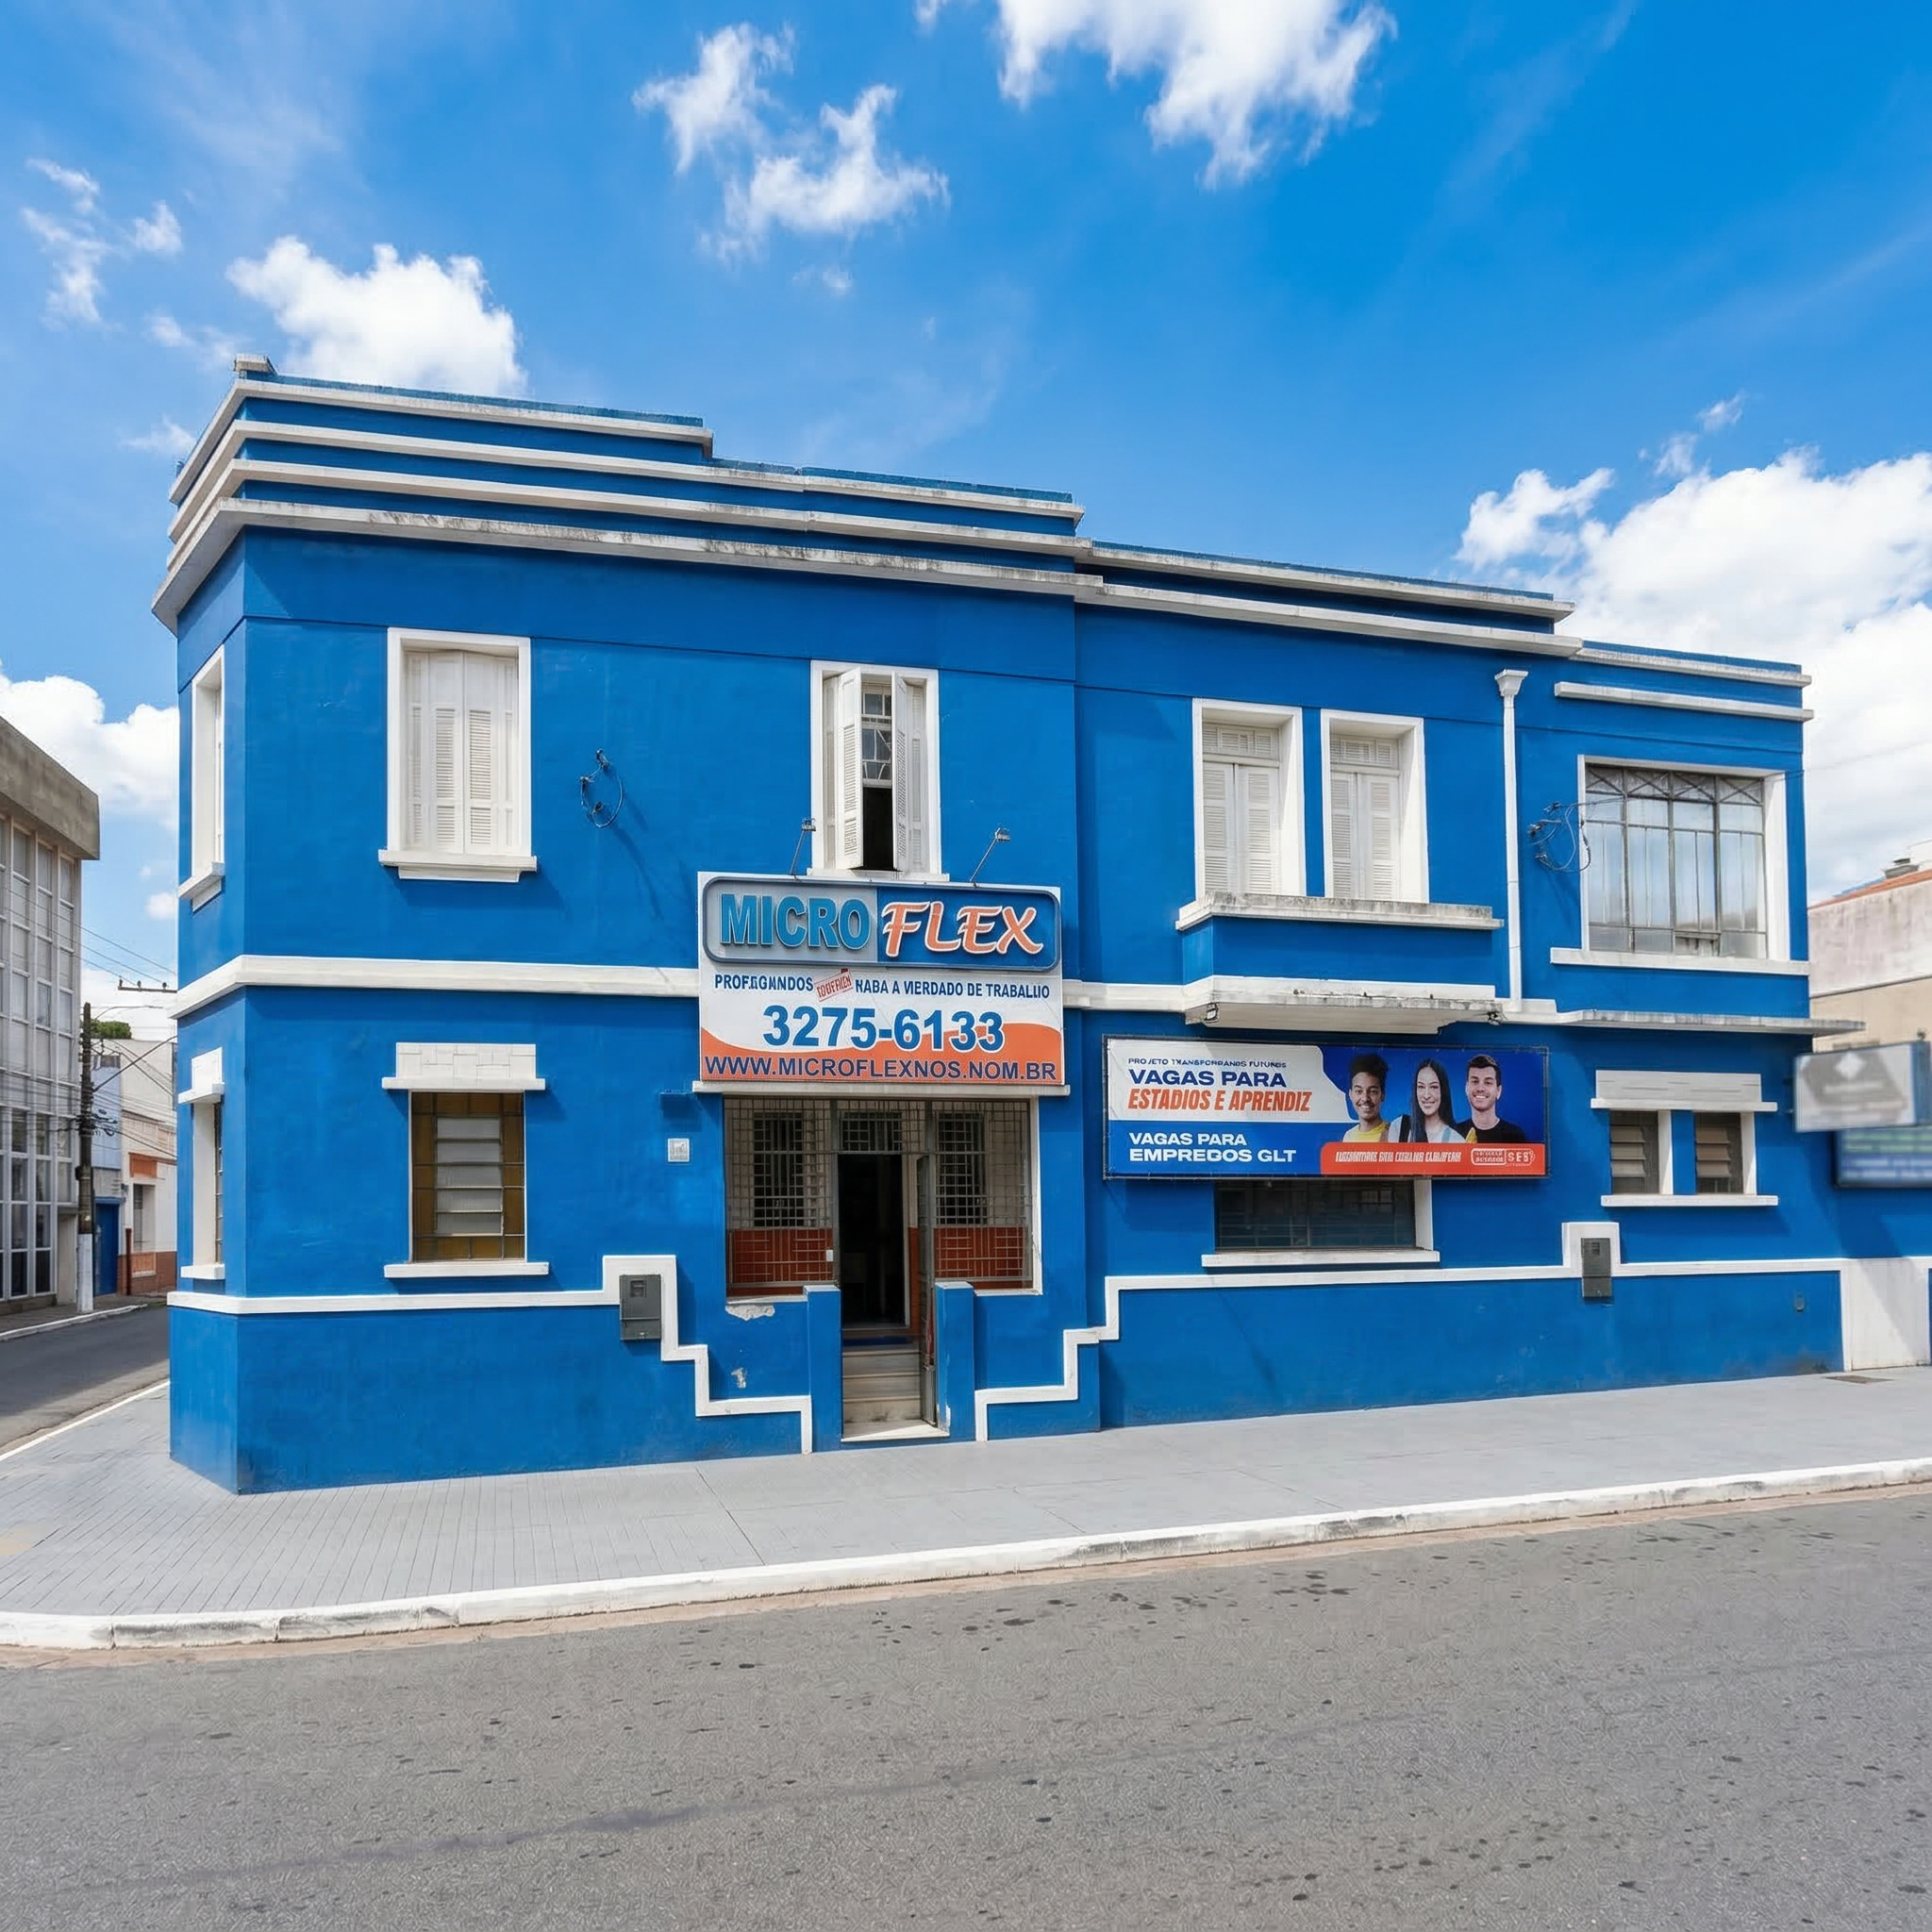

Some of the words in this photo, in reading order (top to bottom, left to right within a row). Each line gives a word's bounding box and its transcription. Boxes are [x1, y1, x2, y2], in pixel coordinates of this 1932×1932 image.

[720, 893, 871, 948] MICRO
[881, 901, 1043, 958] FLEX
[892, 980, 900, 994] A
[967, 983, 982, 996] DE
[763, 1005, 1004, 1052] 3275-6133
[705, 1056, 1057, 1080] WWW.MICROFLEXNOS.NOM.BR
[1128, 1069, 1214, 1085] VAGAS
[1222, 1072, 1287, 1088] PARA
[1127, 1089, 1211, 1110] ESTADIOS
[1214, 1091, 1225, 1110] E
[1228, 1091, 1312, 1111] APRENDIZ
[1129, 1132, 1192, 1145] VAGAS
[1198, 1133, 1247, 1145] PARA
[1257, 1149, 1296, 1162] GLT
